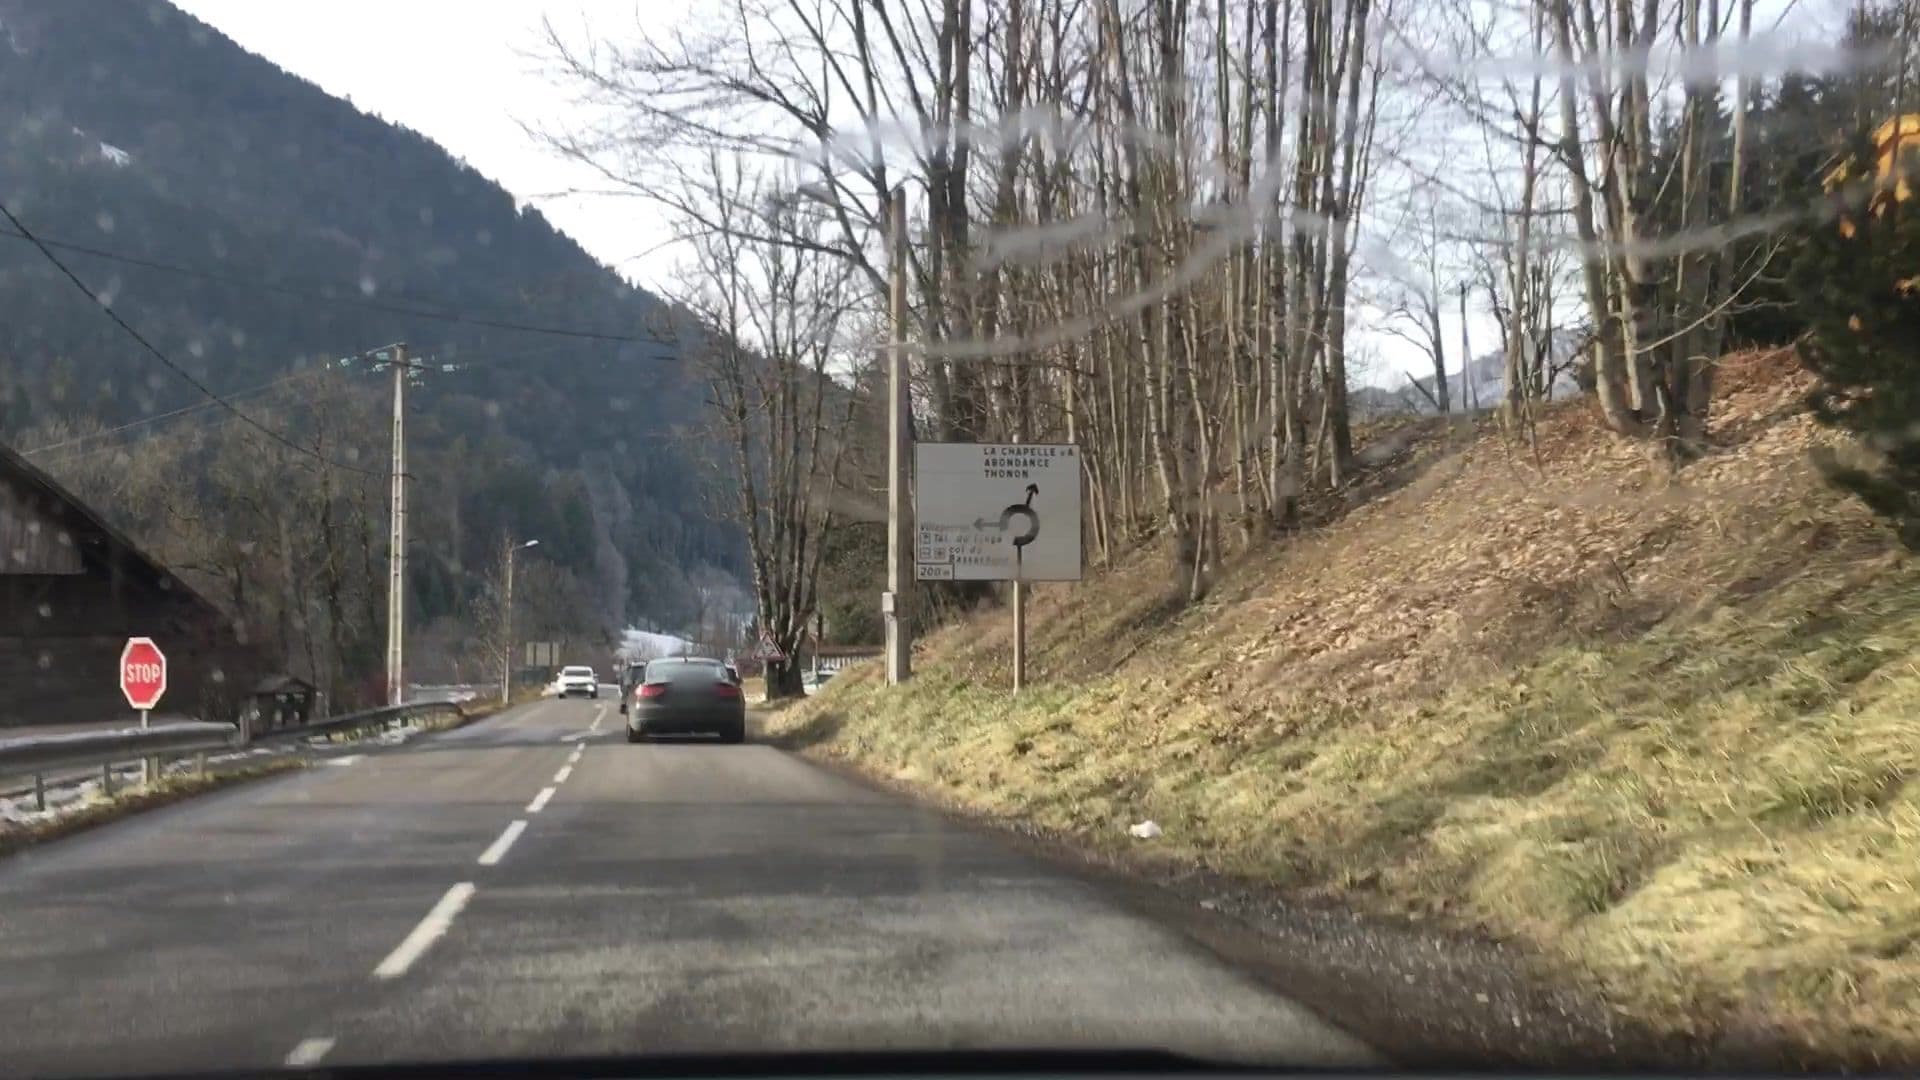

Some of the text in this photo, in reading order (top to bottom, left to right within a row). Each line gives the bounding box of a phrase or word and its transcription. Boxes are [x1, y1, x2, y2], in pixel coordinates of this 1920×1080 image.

[983, 447, 996, 456] LA
[1001, 447, 1056, 456] CHAPELLE
[984, 459, 1050, 468] ABONDANCE
[984, 469, 1029, 478] THONON
[127, 663, 161, 684] STOP
